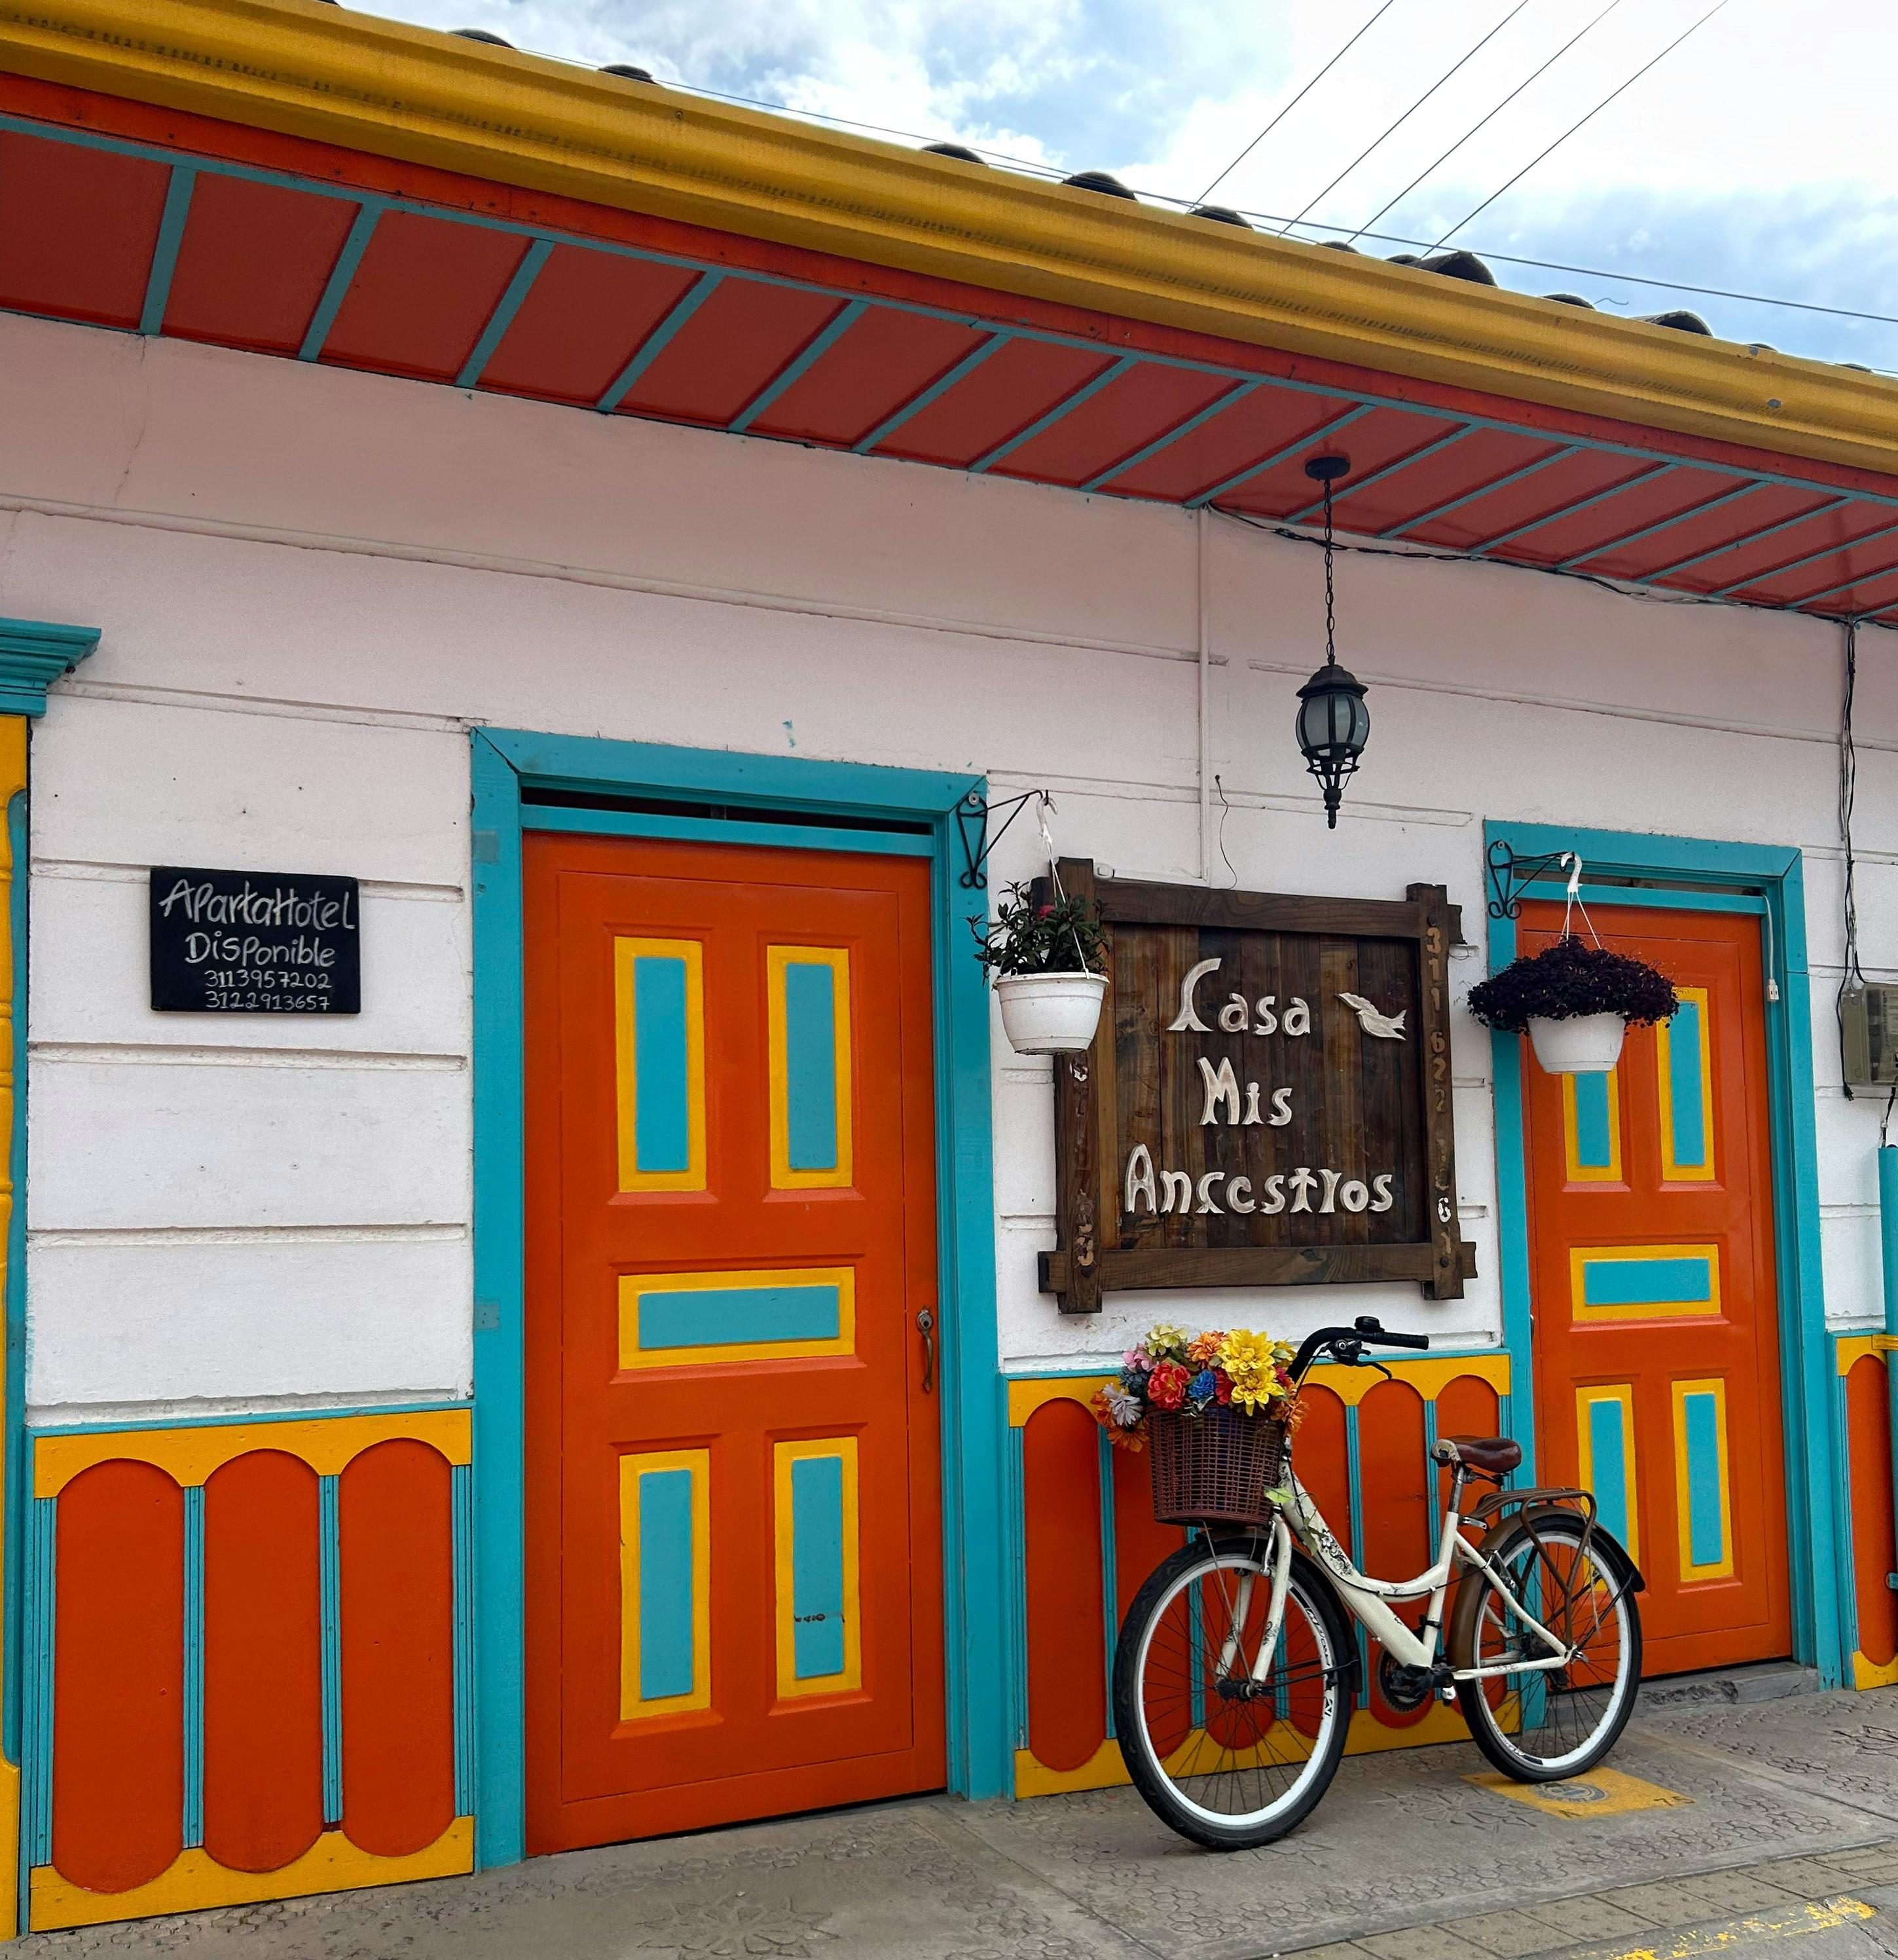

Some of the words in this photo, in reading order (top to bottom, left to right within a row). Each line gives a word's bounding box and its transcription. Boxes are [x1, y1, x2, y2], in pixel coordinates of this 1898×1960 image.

[204, 969, 333, 989] 3113957202
[205, 991, 331, 1010] 3122913657
[1165, 957, 1310, 1037] Casa
[1196, 1056, 1292, 1126] Mis
[1124, 1143, 1393, 1214] Ancestros
